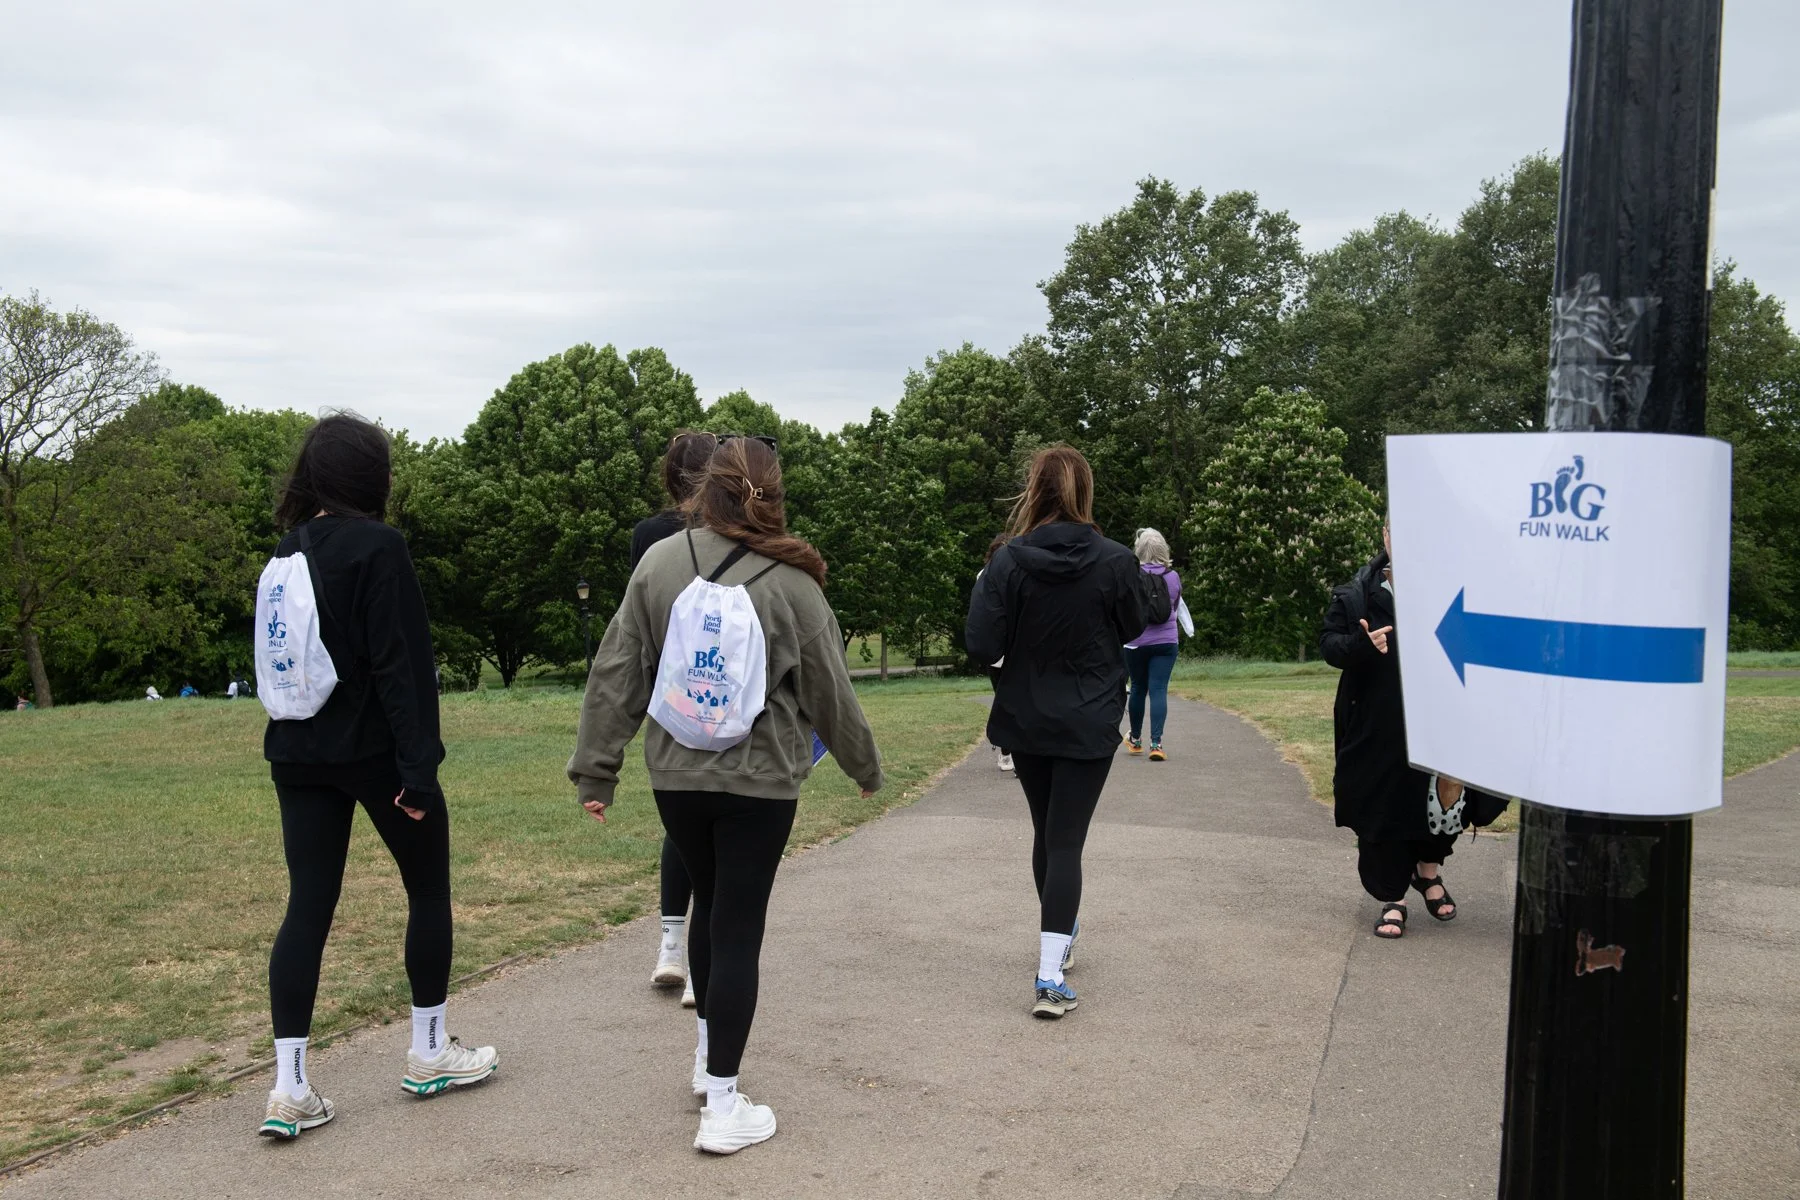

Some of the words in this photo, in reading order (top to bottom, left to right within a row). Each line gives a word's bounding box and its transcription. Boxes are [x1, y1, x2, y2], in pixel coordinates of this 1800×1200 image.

[1528, 466, 1606, 522] BIG
[1519, 521, 1551, 537] FUN
[1555, 523, 1610, 542] WALK
[703, 620, 721, 628] Lond
[703, 625, 721, 635] Hosp
[687, 668, 706, 678] FUN
[707, 671, 728, 682] WLK
[428, 1015, 438, 1050] SALOMON
[294, 1047, 303, 1085] SALOMON
